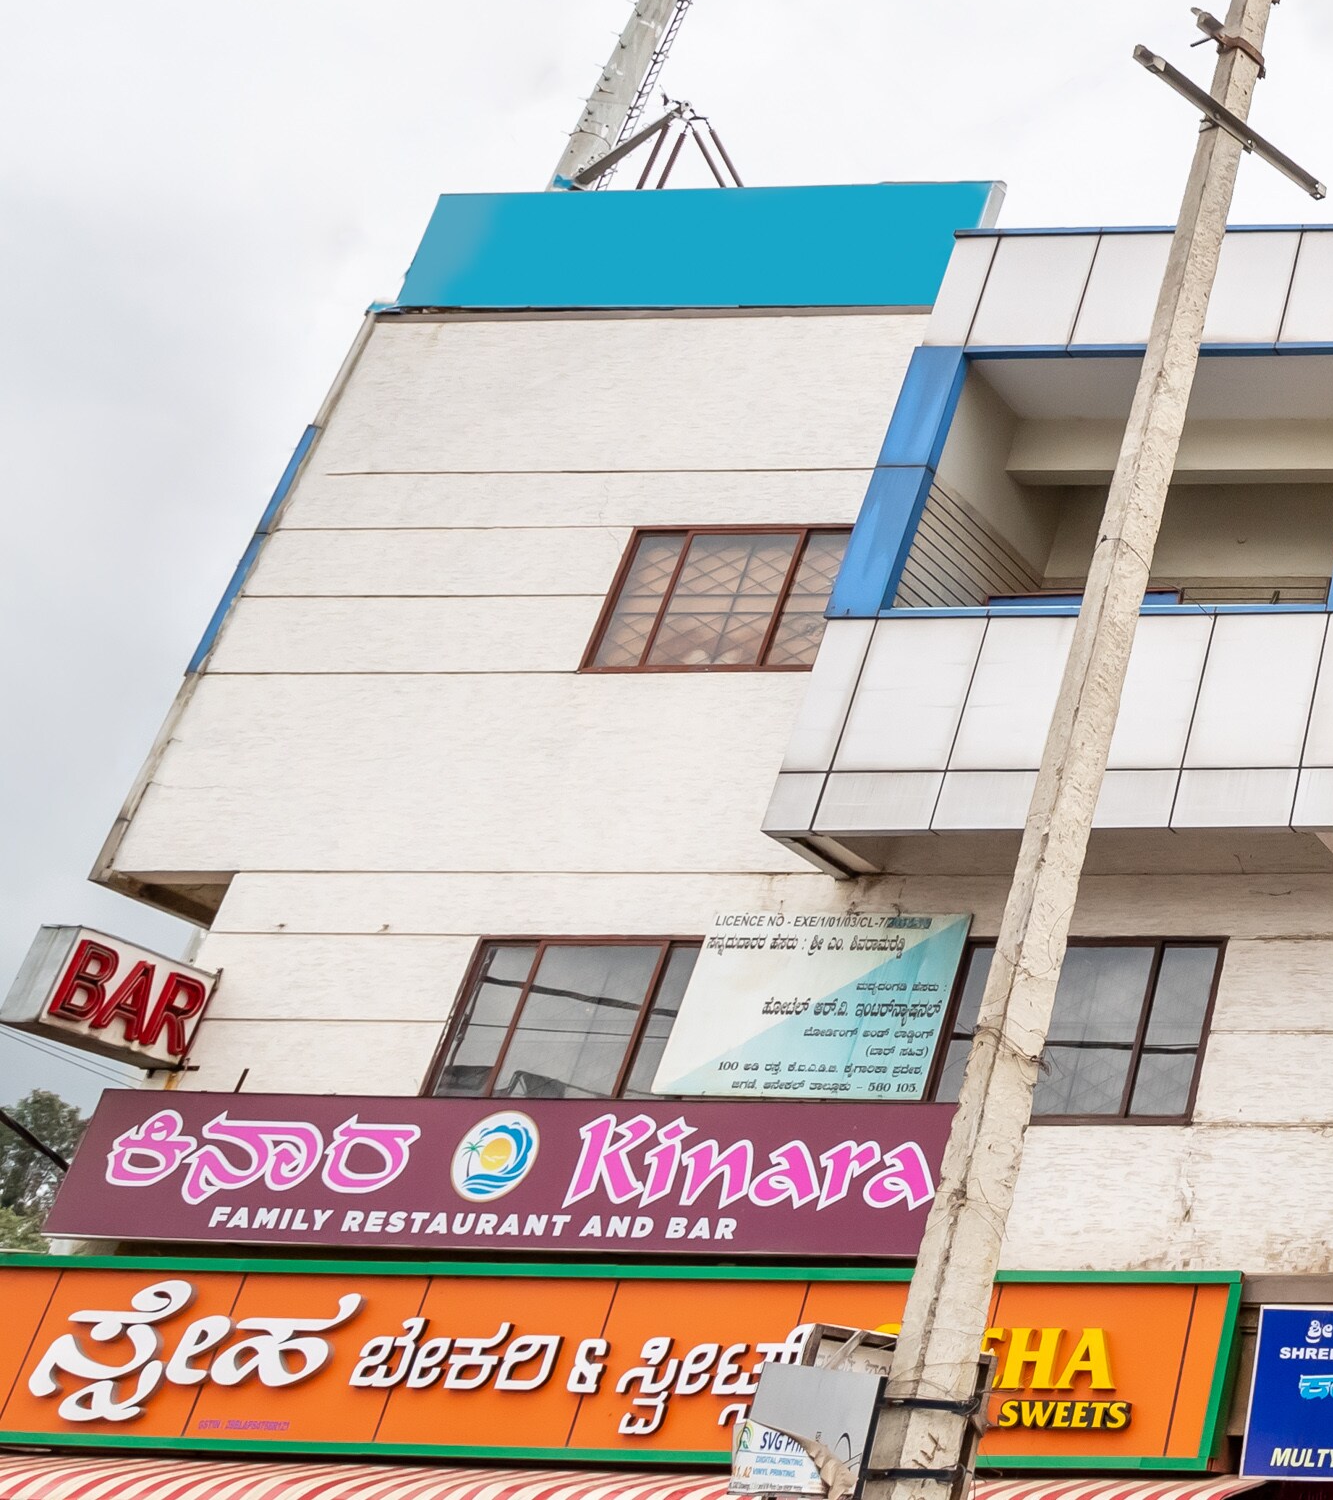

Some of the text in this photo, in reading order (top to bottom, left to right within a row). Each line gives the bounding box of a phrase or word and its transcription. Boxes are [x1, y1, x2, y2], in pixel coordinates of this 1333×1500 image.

[715, 915, 765, 927] LICENCE
[767, 915, 785, 927] NO
[769, 933, 799, 950] ಹೆಸರು
[807, 934, 824, 956] ಶ್ರೀ
[48, 939, 208, 1057] BAR
[911, 981, 940, 992] ಹೆಸರು
[717, 1061, 739, 1071] 100
[105, 1109, 422, 1205] ಕಿನಾರ
[562, 1113, 936, 1212] Kinara
[208, 1206, 738, 1241] FAMILY RESTAURANT AND BAR
[1305, 1319, 1333, 1343] ಶ್ರೀ
[28, 1279, 365, 1422] ಸ್ನೇಹ
[349, 1316, 564, 1392] ಬೇಕರಿ
[566, 1338, 608, 1394] &
[998, 1400, 1130, 1430] SWEETS
[760, 1431, 783, 1451] SVG
